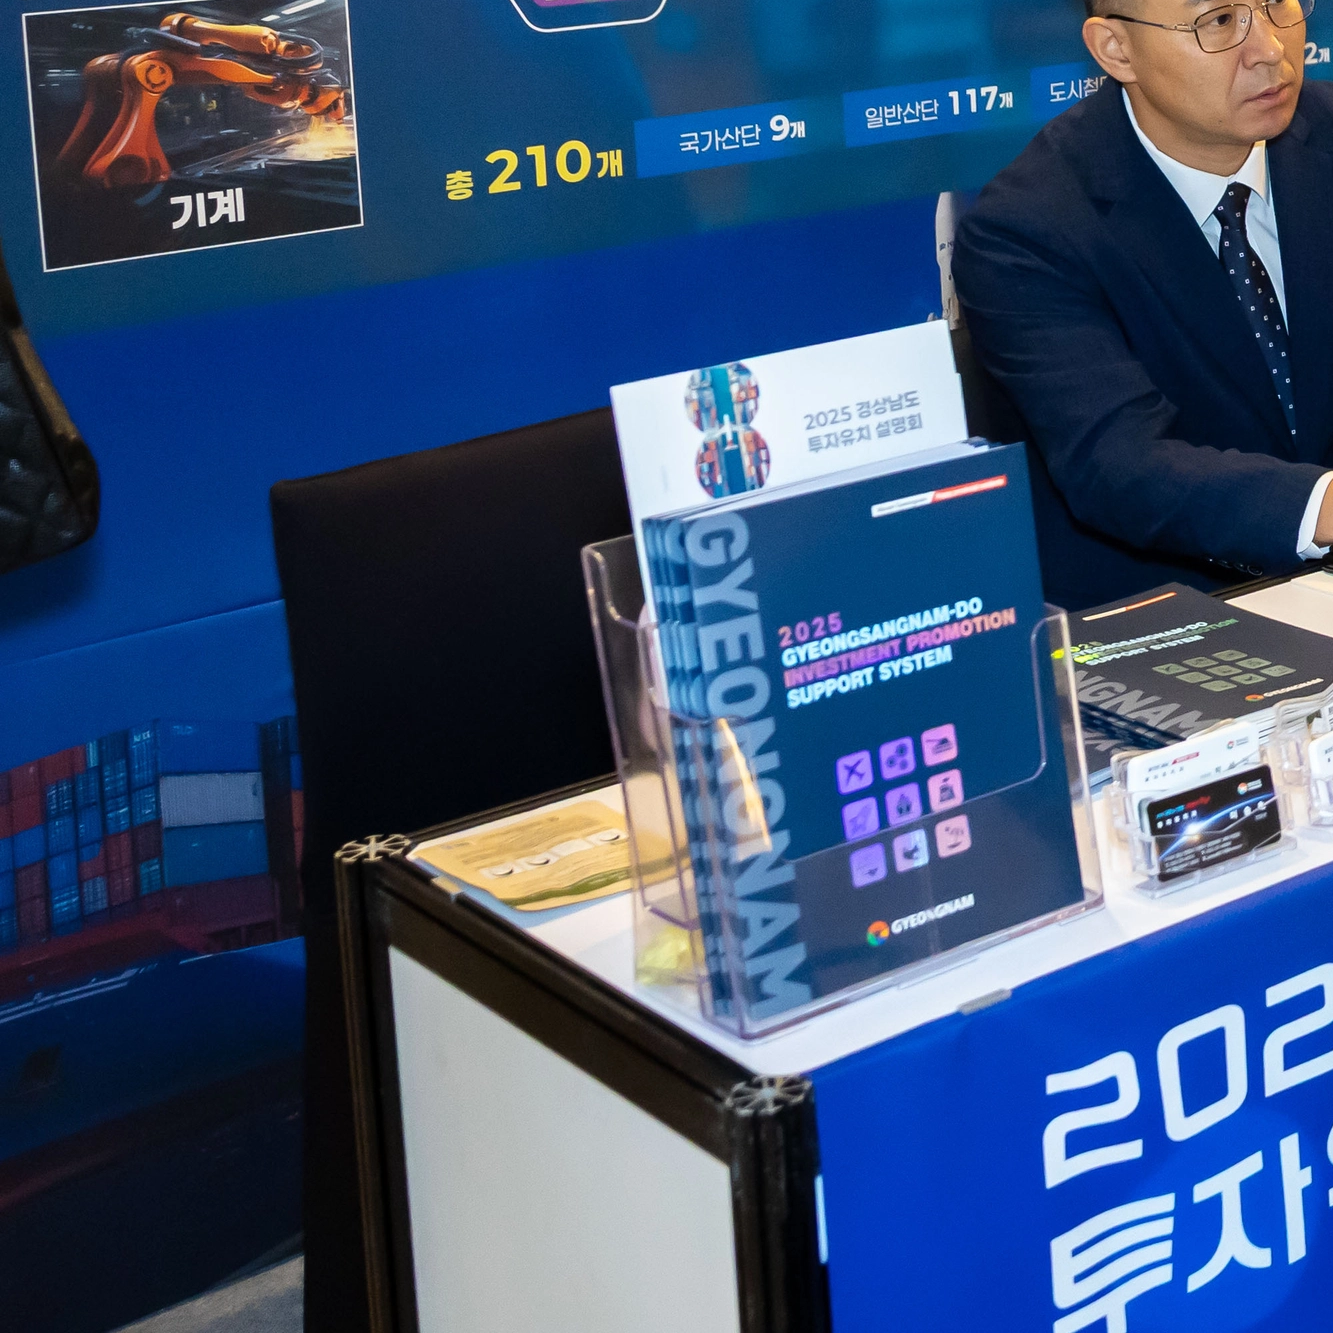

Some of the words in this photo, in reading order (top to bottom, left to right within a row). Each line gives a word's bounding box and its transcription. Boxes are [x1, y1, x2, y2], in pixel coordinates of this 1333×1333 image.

[864, 99, 940, 130] 일반산단
[948, 84, 1014, 117] 117개
[679, 123, 762, 155] 국가산단
[769, 114, 807, 143] 9개
[445, 169, 474, 202] 총
[485, 139, 625, 195] 210개
[170, 187, 246, 230] 기계
[803, 404, 852, 432] 2025
[855, 390, 921, 420] 경상남도
[807, 426, 872, 454] 투자유치
[874, 413, 924, 440] 설명회
[778, 611, 843, 648] 2025
[781, 596, 984, 669] GYEONGSANGNAM-DO
[783, 638, 902, 690] INVESTMENT
[904, 606, 1017, 654] PROMOTION
[786, 666, 875, 711] SUPPORT
[877, 644, 954, 683] SYSTEM
